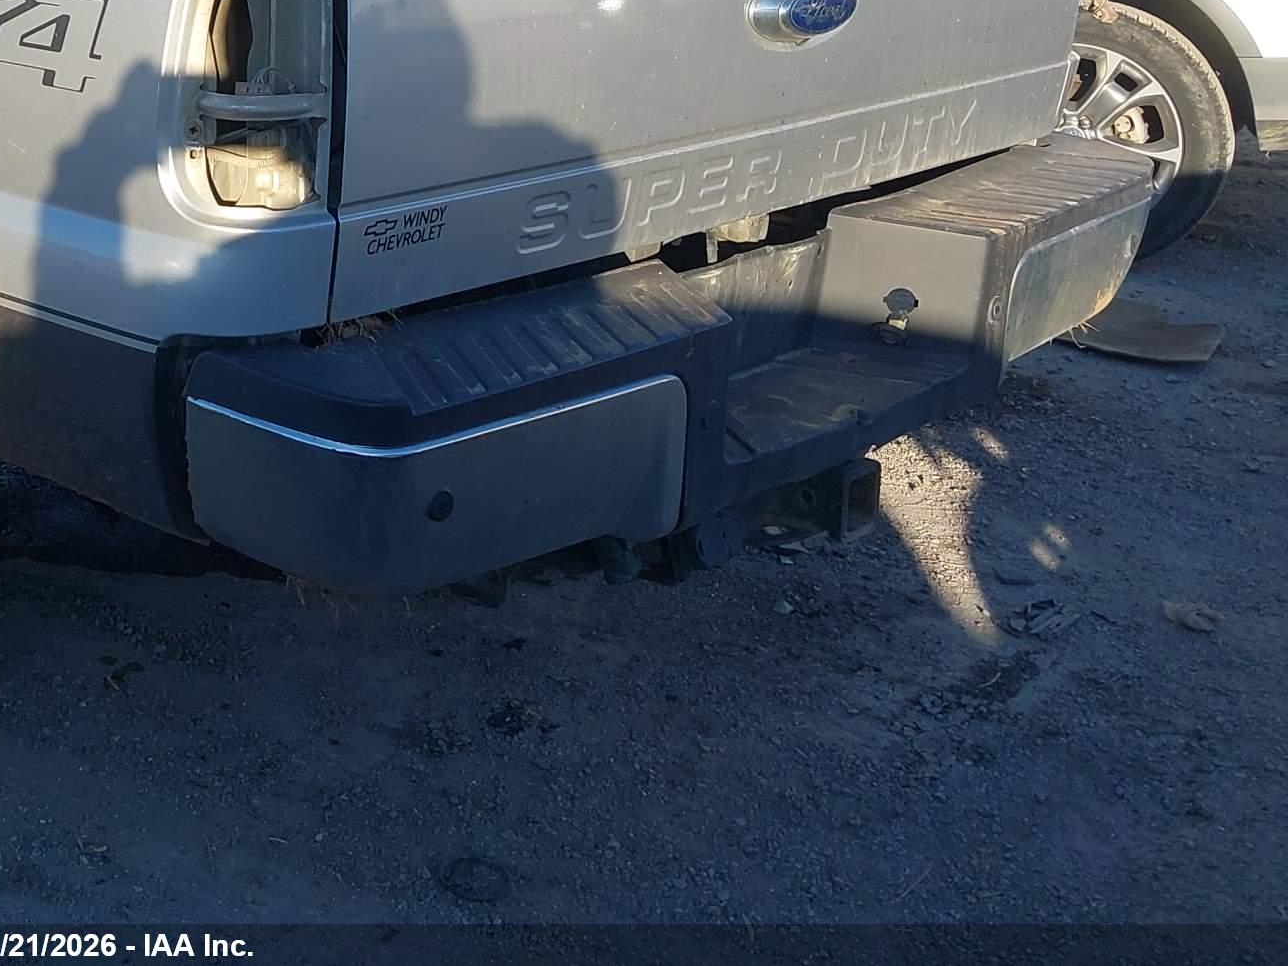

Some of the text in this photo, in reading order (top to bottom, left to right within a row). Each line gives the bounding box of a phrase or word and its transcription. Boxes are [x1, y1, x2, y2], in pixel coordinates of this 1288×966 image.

[515, 97, 978, 255] SUPER DUTY
[403, 205, 448, 229] WINDY
[367, 223, 446, 255] CHEVROLET
